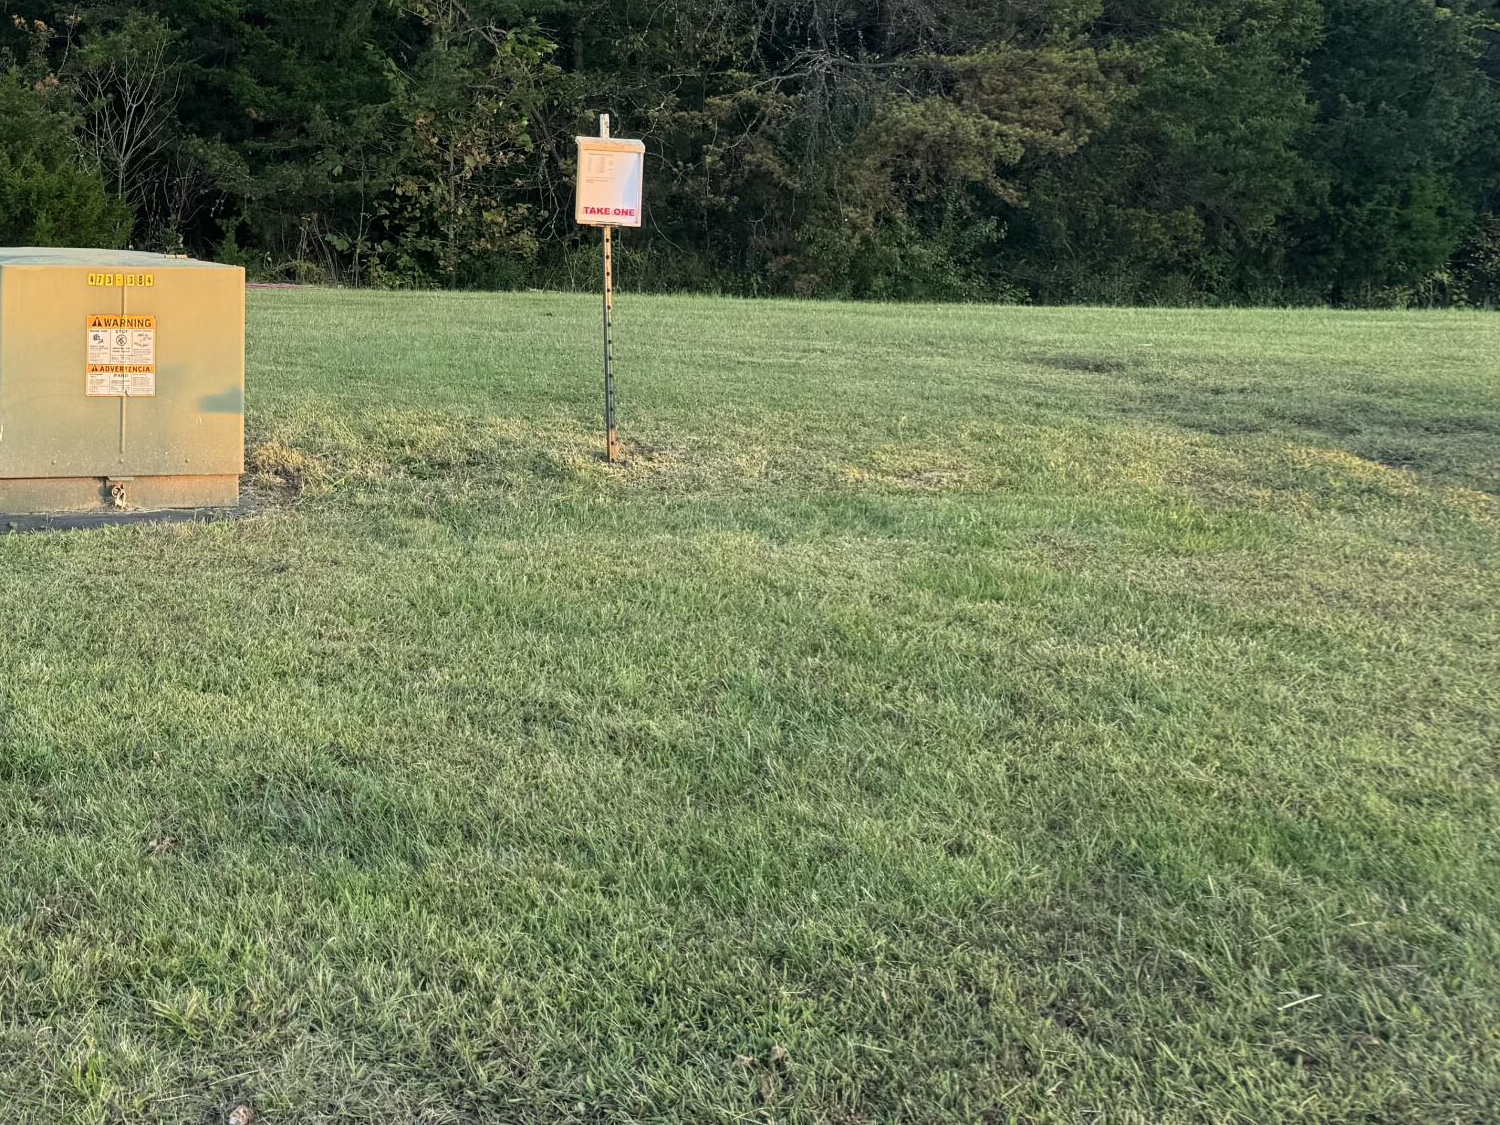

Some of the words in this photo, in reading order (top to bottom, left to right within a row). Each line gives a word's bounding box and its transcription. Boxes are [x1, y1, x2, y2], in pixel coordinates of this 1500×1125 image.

[584, 207, 610, 215] TAKE
[613, 208, 635, 216] ONE
[104, 318, 152, 327] WARNING
[99, 365, 150, 373] ADVERTENCIA
